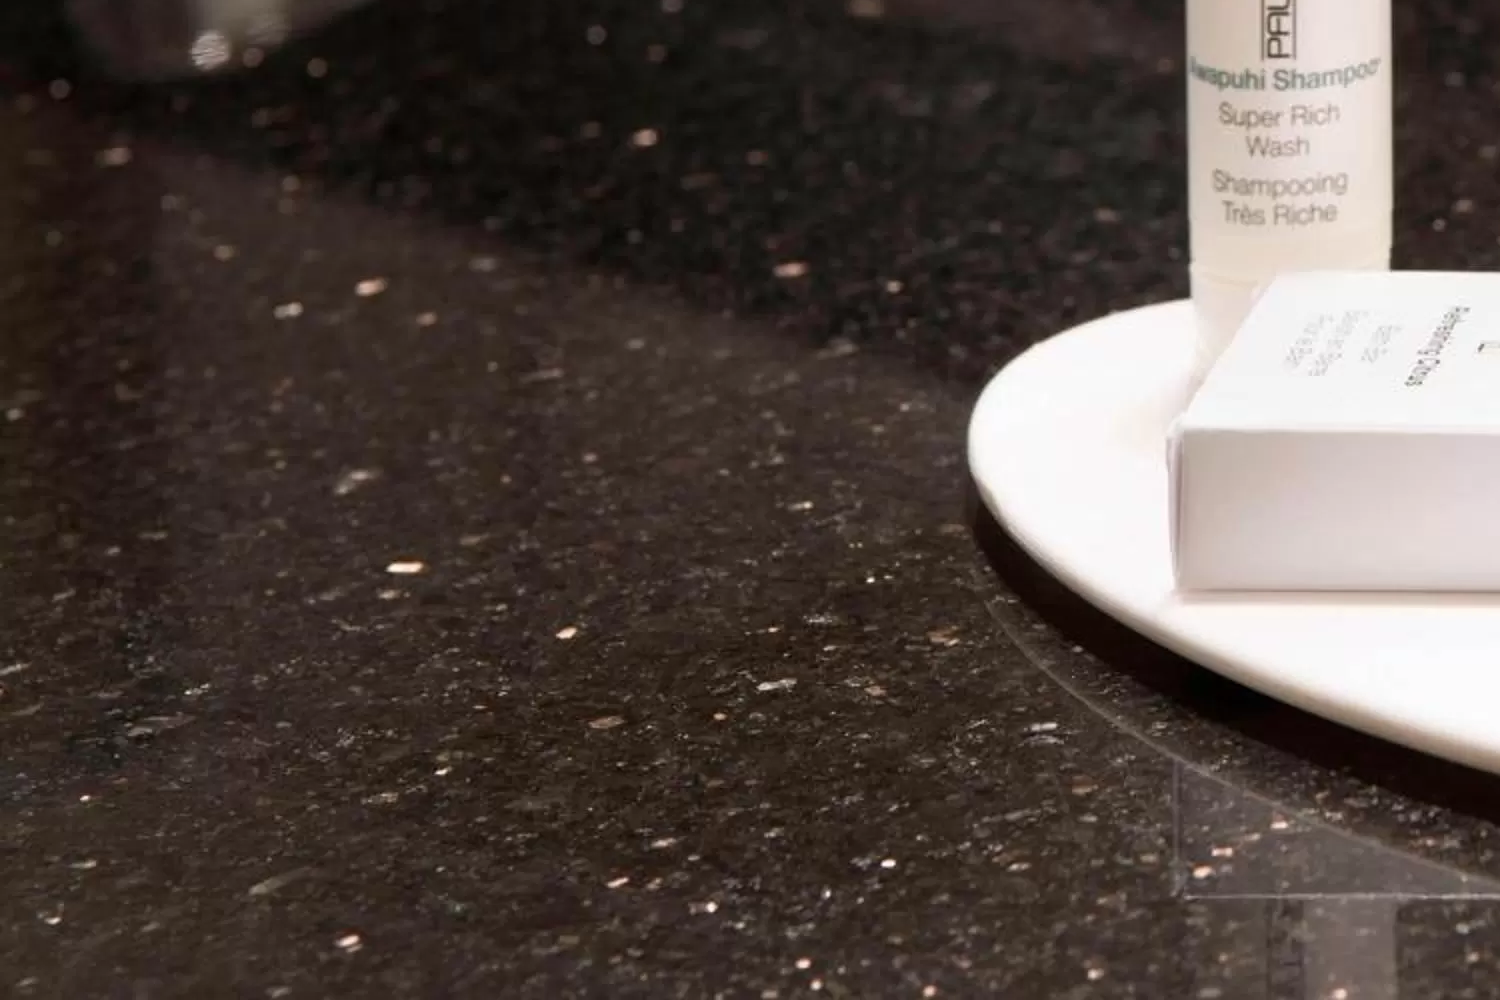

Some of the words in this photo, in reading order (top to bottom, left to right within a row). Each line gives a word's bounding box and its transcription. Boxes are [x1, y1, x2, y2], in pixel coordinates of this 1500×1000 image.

[1218, 101, 1284, 130] Super
[1290, 102, 1341, 127] Rich
[1245, 135, 1310, 158] Wash
[1212, 168, 1349, 199] Shampooing
[1273, 203, 1339, 227] Riche
